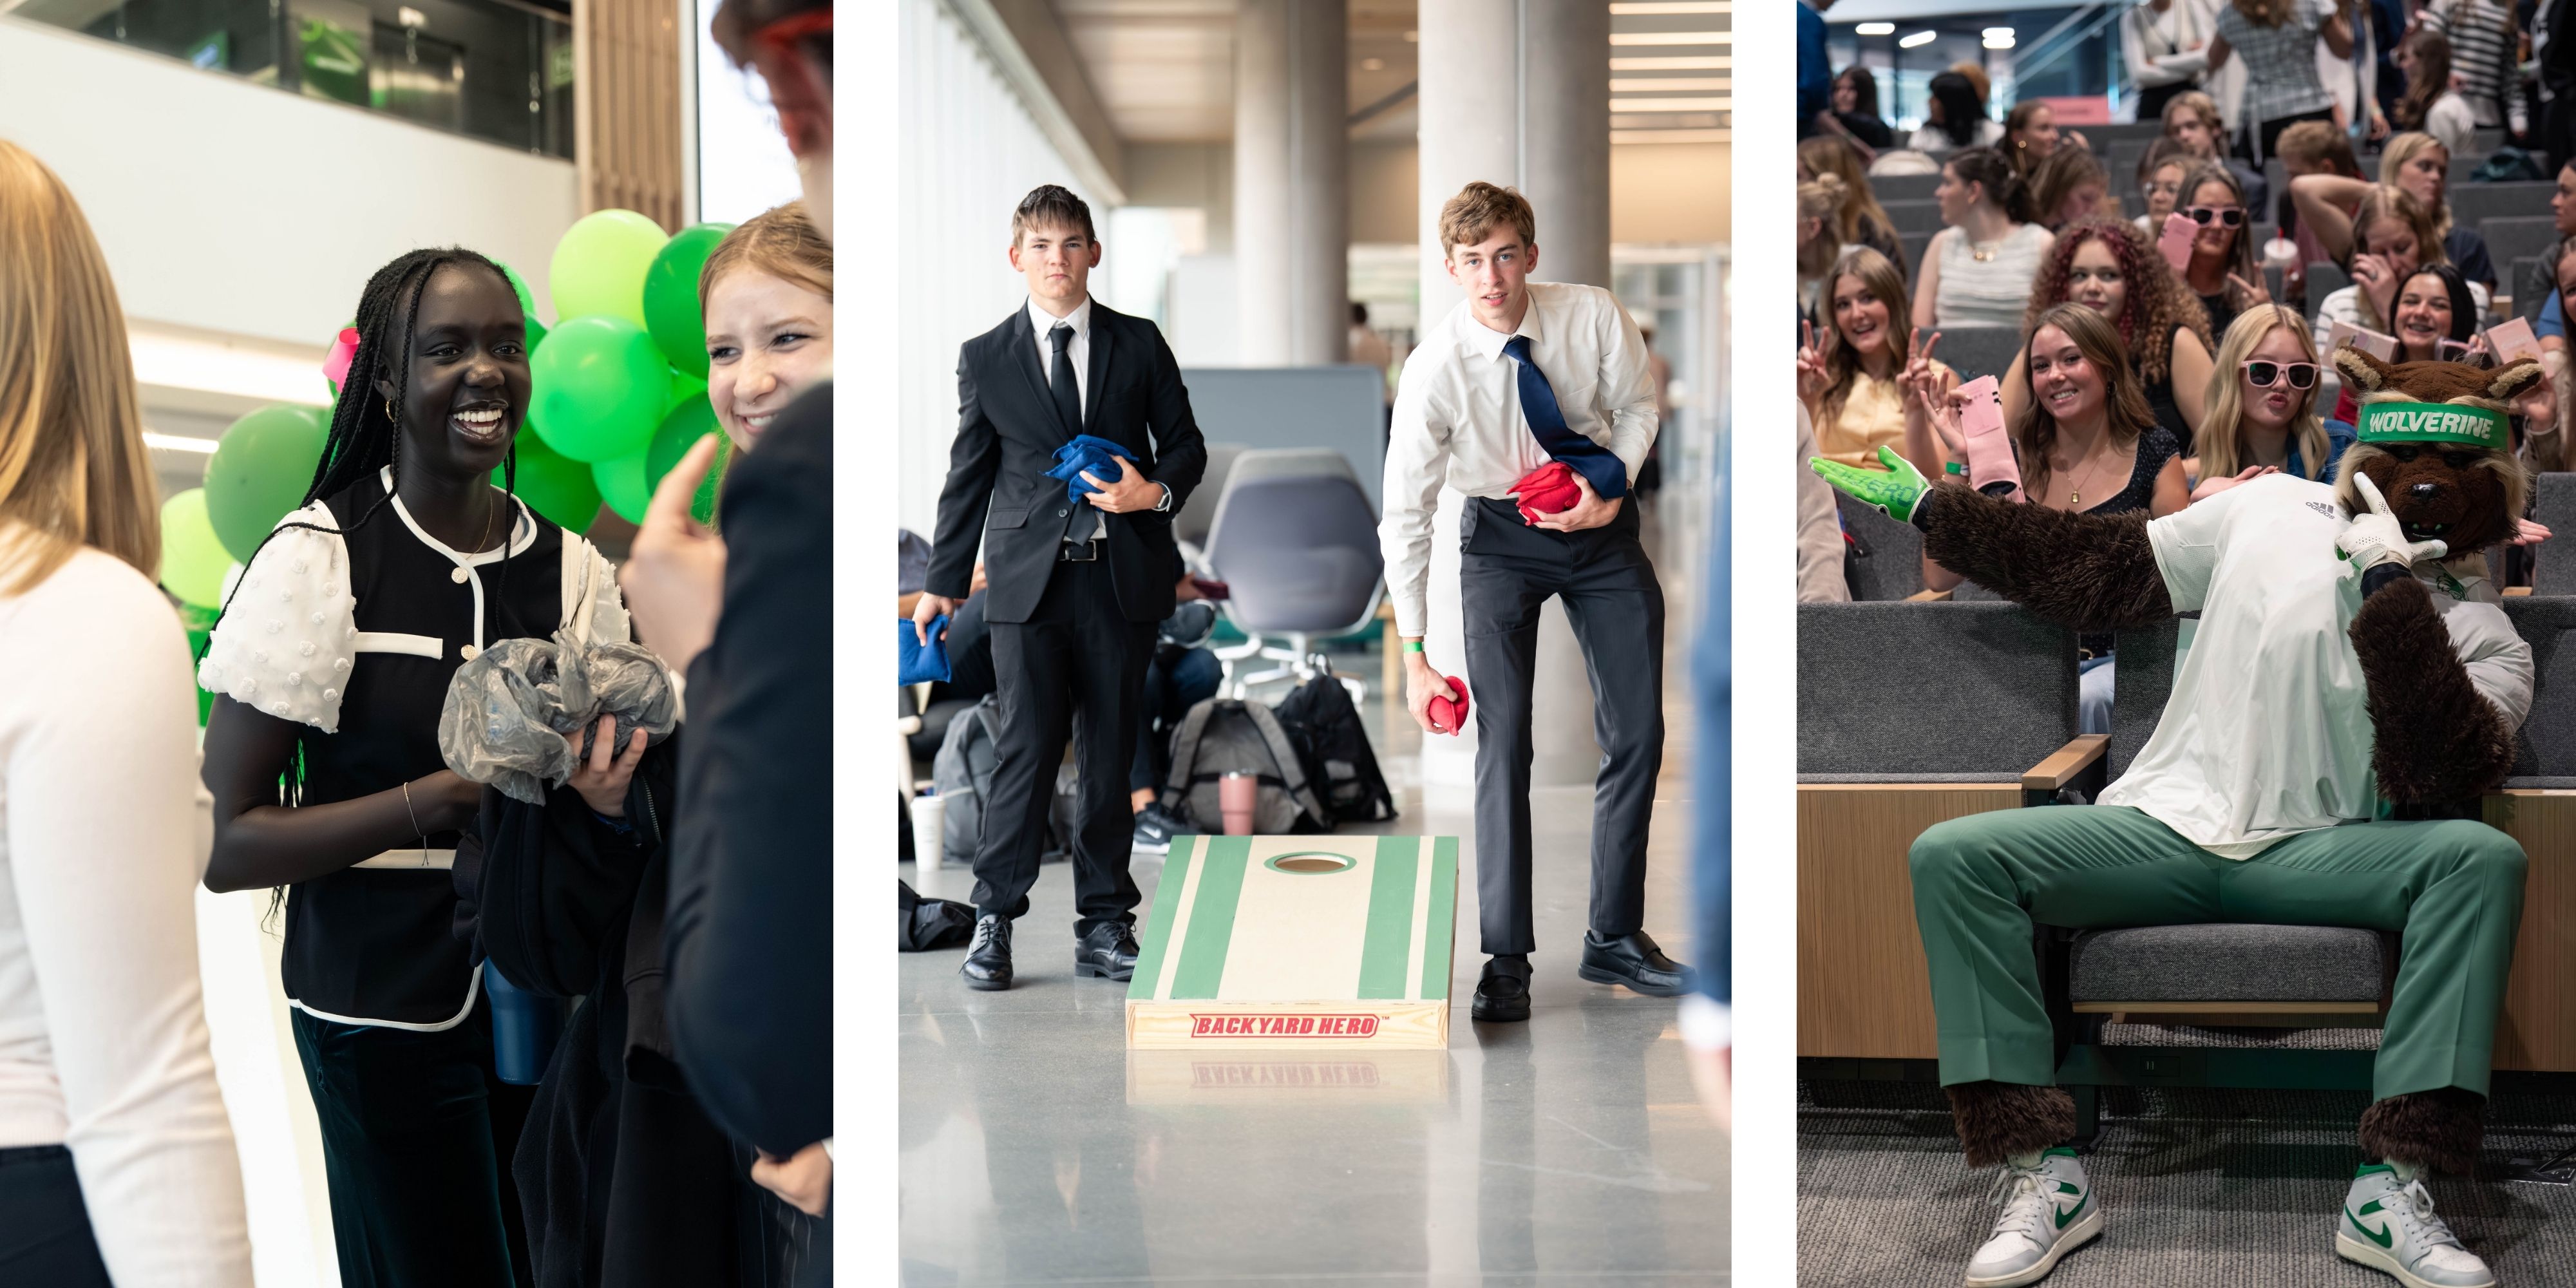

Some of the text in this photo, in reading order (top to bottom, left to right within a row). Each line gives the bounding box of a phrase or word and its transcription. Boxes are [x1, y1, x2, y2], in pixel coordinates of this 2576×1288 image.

[2370, 412, 2494, 440] WOLVERINE
[2306, 502, 2335, 520] adidas
[1197, 1018, 1315, 1034] BACKYARD
[1318, 1018, 1375, 1034] HERO
